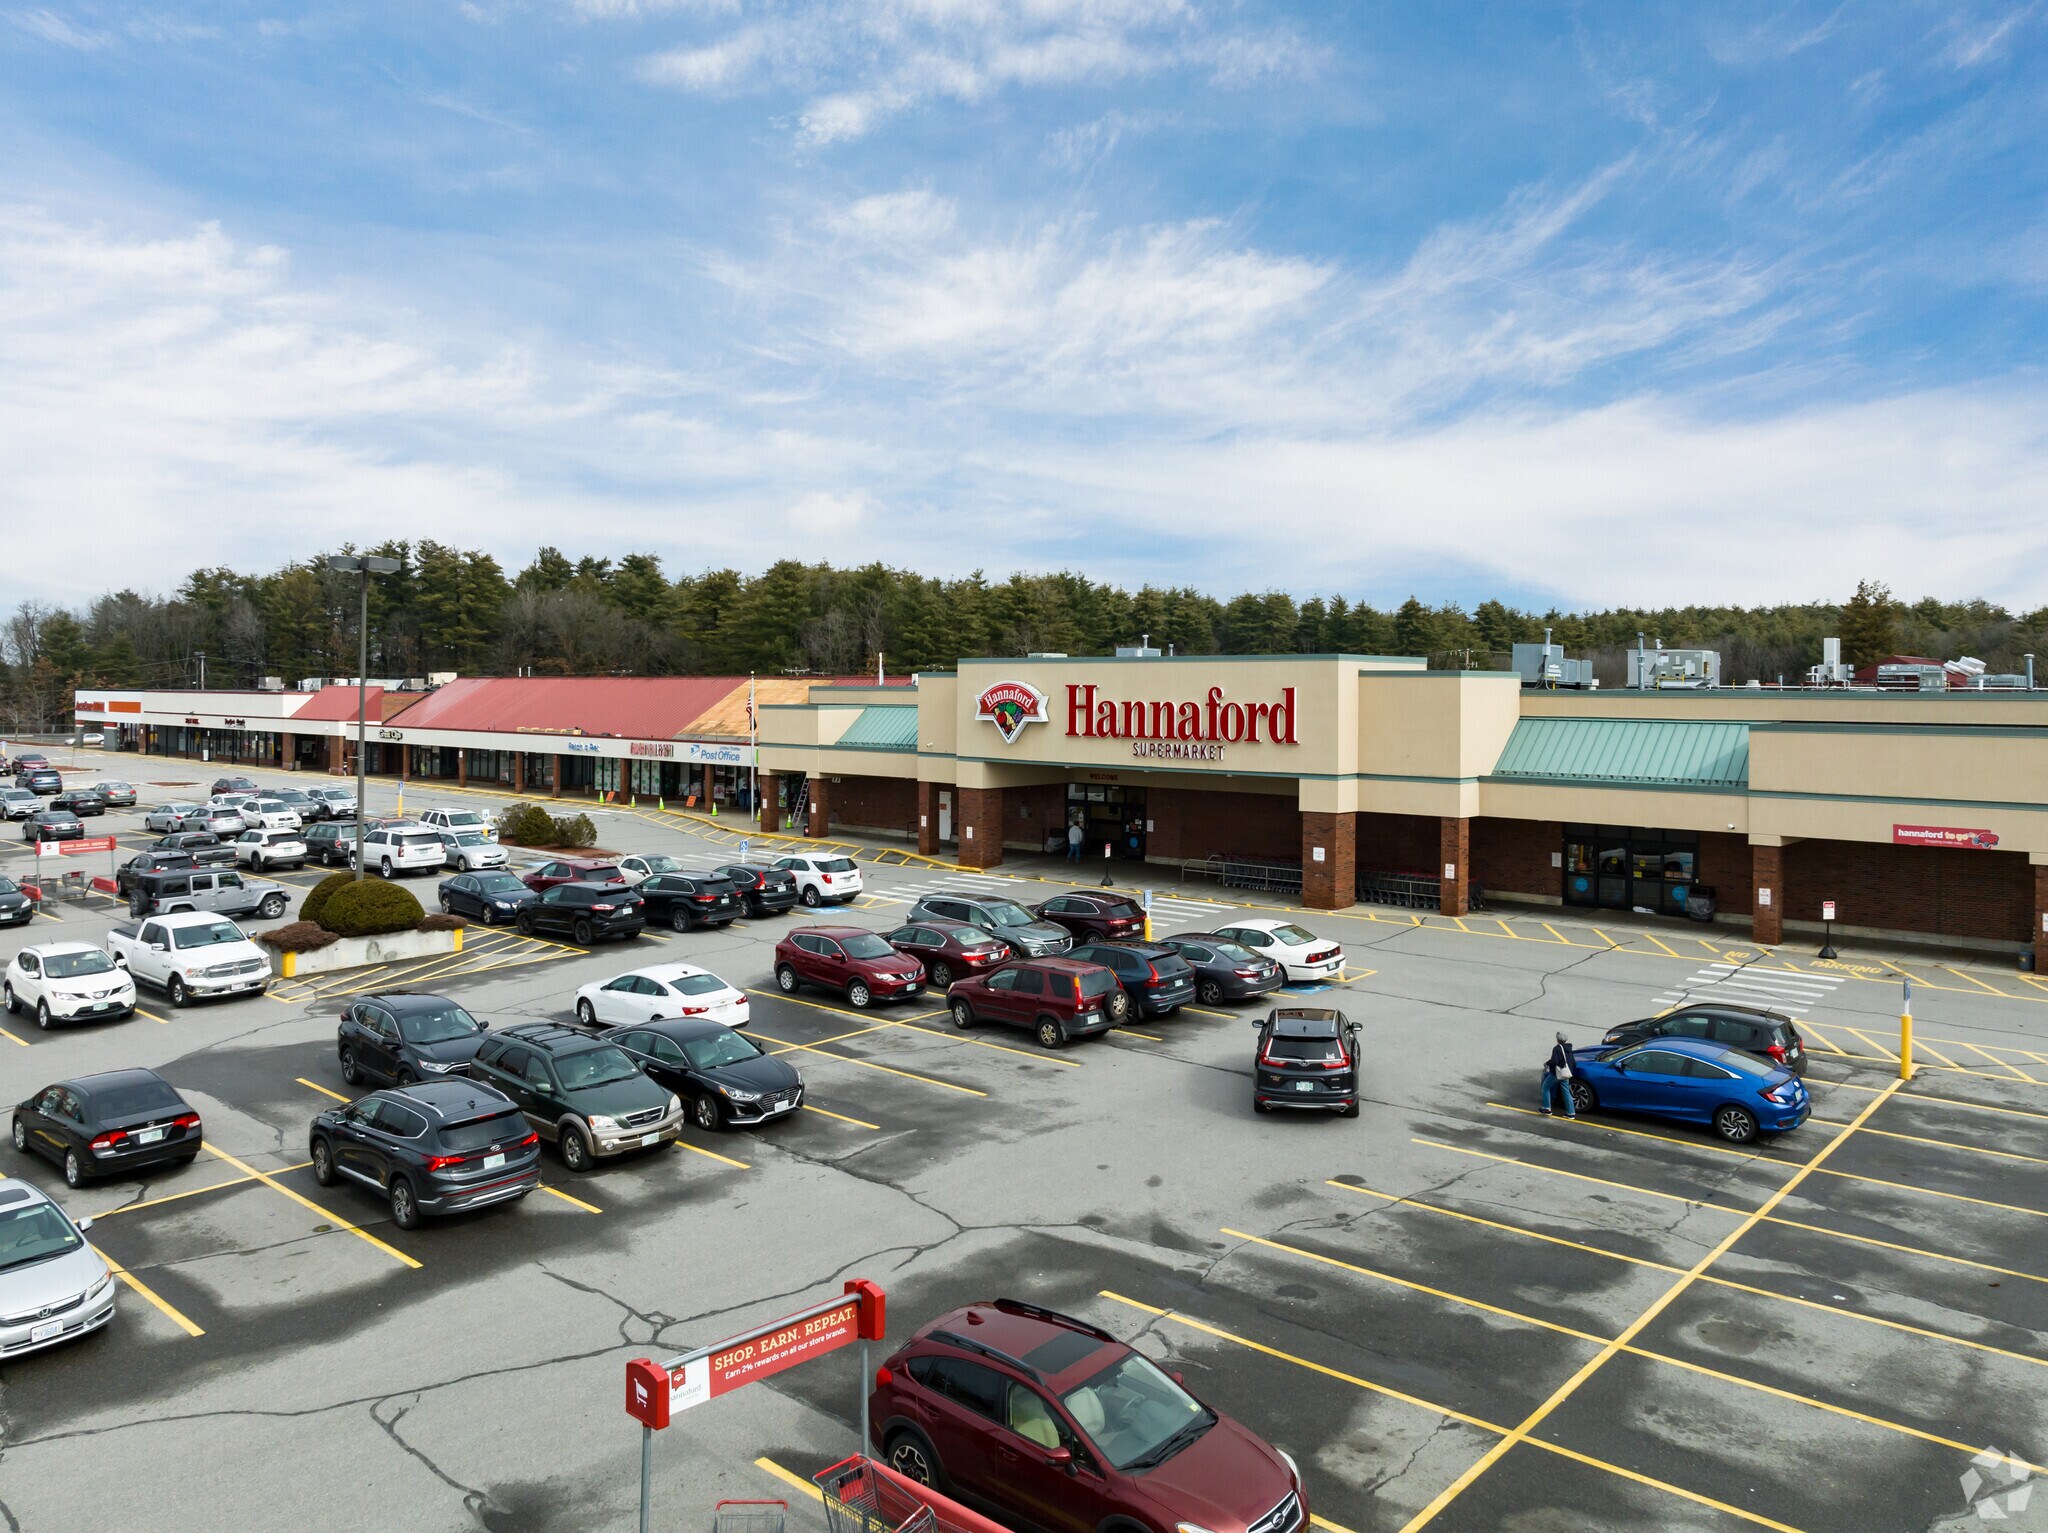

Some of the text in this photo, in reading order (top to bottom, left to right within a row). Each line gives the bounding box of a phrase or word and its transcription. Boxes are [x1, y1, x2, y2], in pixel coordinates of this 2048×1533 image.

[984, 689, 1034, 708] Hannaford
[1065, 684, 1300, 745] Hannaford
[701, 750, 740, 761] Post Office
[1132, 742, 1225, 760] SUPERMARKET
[1898, 829, 1943, 838] hannaford
[1944, 831, 1956, 840] to
[1725, 951, 1751, 959] NO
[1809, 960, 1884, 974] PARKING
[714, 1308, 855, 1372] SHOP. EARN. REPEAT.
[725, 1328, 848, 1380] Earn 2% rewards on all our store brands.
[670, 1384, 702, 1402] annaford
